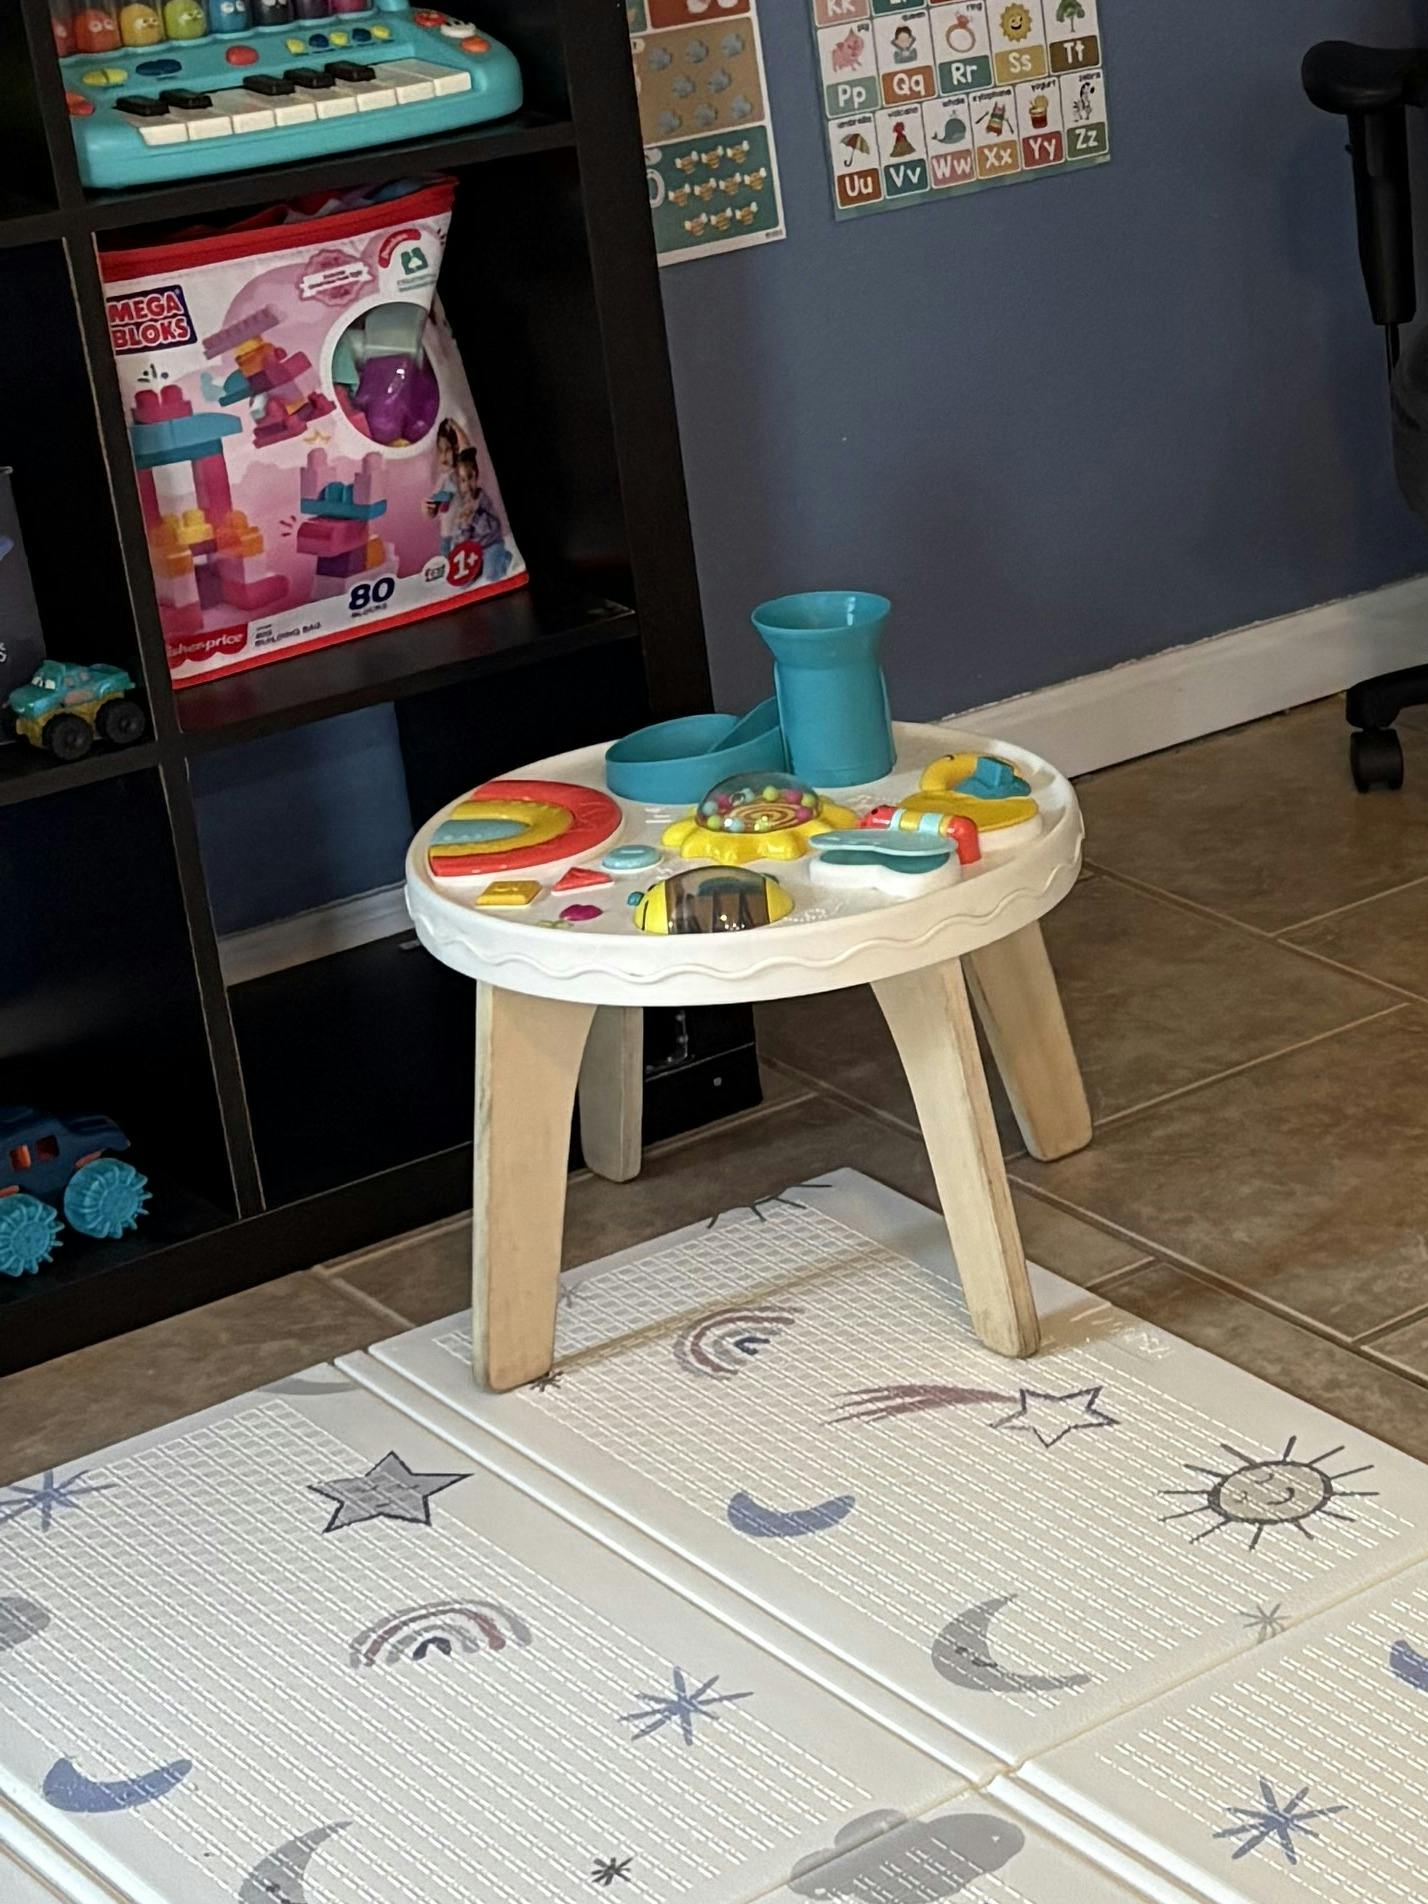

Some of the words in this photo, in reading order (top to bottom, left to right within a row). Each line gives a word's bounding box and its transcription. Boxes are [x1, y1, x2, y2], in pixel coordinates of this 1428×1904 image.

[893, 74, 924, 96] Qq
[952, 63, 978, 85] Rr
[1063, 41, 1084, 63] Tt
[890, 165, 921, 187] Vv
[932, 156, 971, 179] Ww
[984, 147, 1011, 168] Xx
[1075, 128, 1097, 149] Zz
[107, 292, 183, 324] MEGA
[111, 318, 190, 350] BLOKS
[452, 545, 479, 580] 1+
[349, 577, 396, 611] 80
